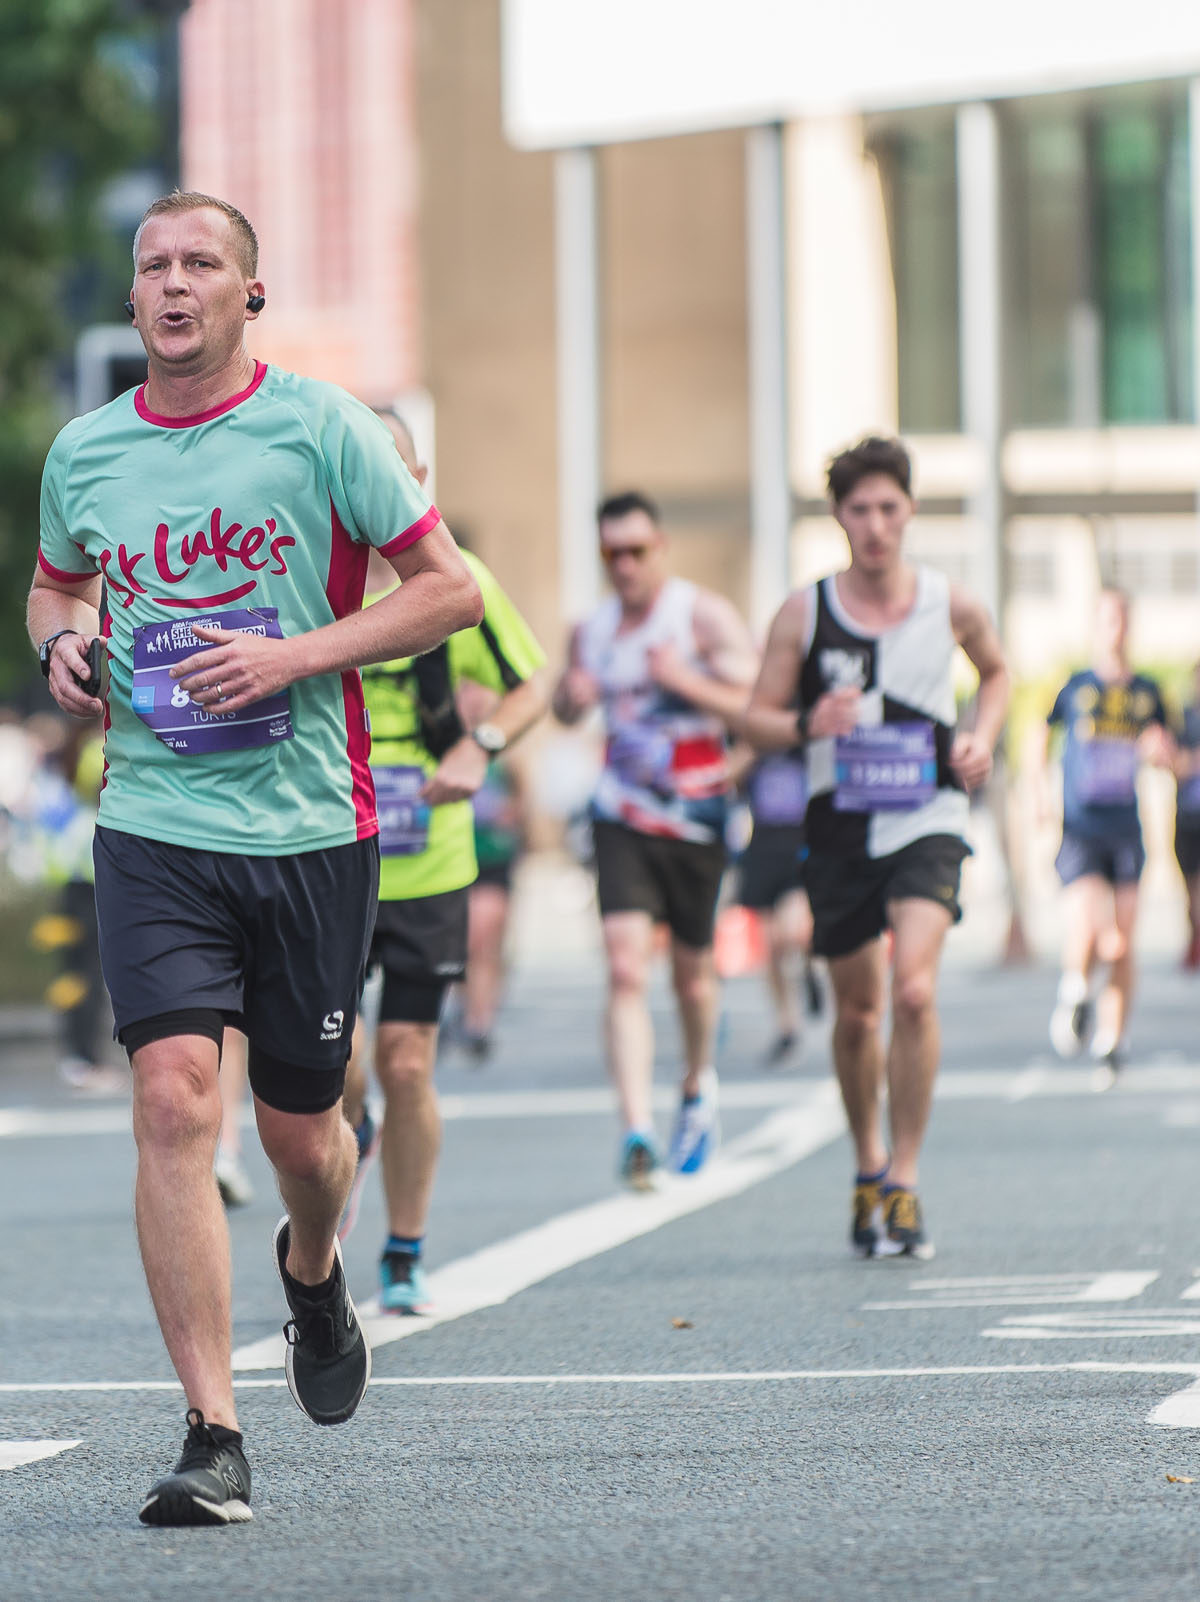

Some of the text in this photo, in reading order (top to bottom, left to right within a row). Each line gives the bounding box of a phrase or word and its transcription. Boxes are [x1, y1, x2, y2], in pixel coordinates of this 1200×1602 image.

[154, 507, 296, 584] Luke's
[174, 637, 198, 649] HALF
[175, 740, 188, 748] ALL
